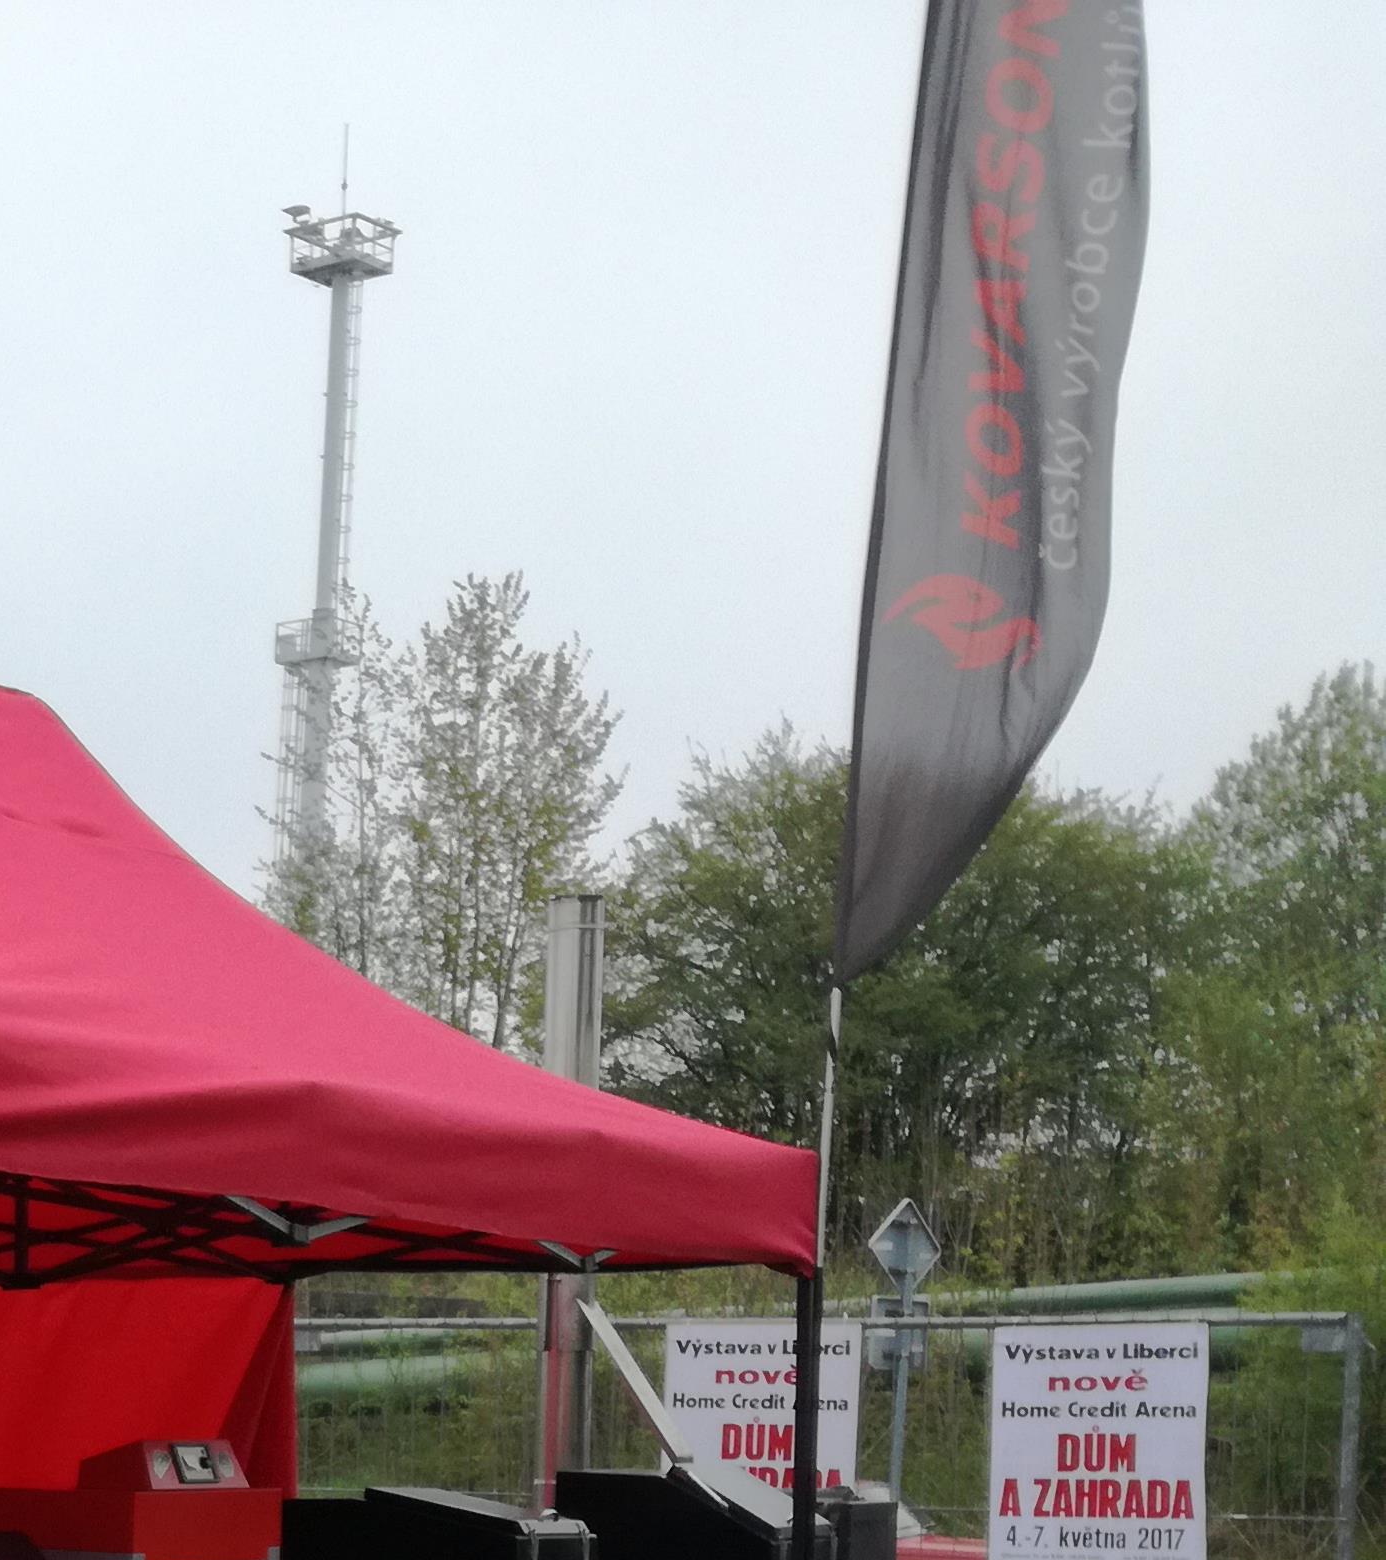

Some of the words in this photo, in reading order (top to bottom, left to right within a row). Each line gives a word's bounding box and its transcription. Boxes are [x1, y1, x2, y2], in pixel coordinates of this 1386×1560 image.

[1054, 172, 1125, 401] výrobce
[1038, 417, 1093, 572] český
[676, 1338, 762, 1358] Výstava
[767, 1343, 777, 1355] v
[782, 1339, 851, 1356] Lirci
[1005, 1343, 1100, 1364] Výstava
[1106, 1347, 1117, 1360] v
[1123, 1342, 1198, 1360] Liberci
[1048, 1368, 1148, 1392] nově
[672, 1393, 726, 1409] Home
[732, 1394, 786, 1410] Credit
[1001, 1401, 1061, 1418] Home
[1067, 1401, 1127, 1418] Credit
[1135, 1401, 1197, 1418] Arena
[720, 1416, 796, 1461] DŮM
[1057, 1425, 1137, 1472] DŮM
[998, 1478, 1021, 1517] A
[1033, 1478, 1195, 1519] ZAHRADA
[1059, 1526, 1127, 1549] května
[1137, 1527, 1186, 1550] 2017
